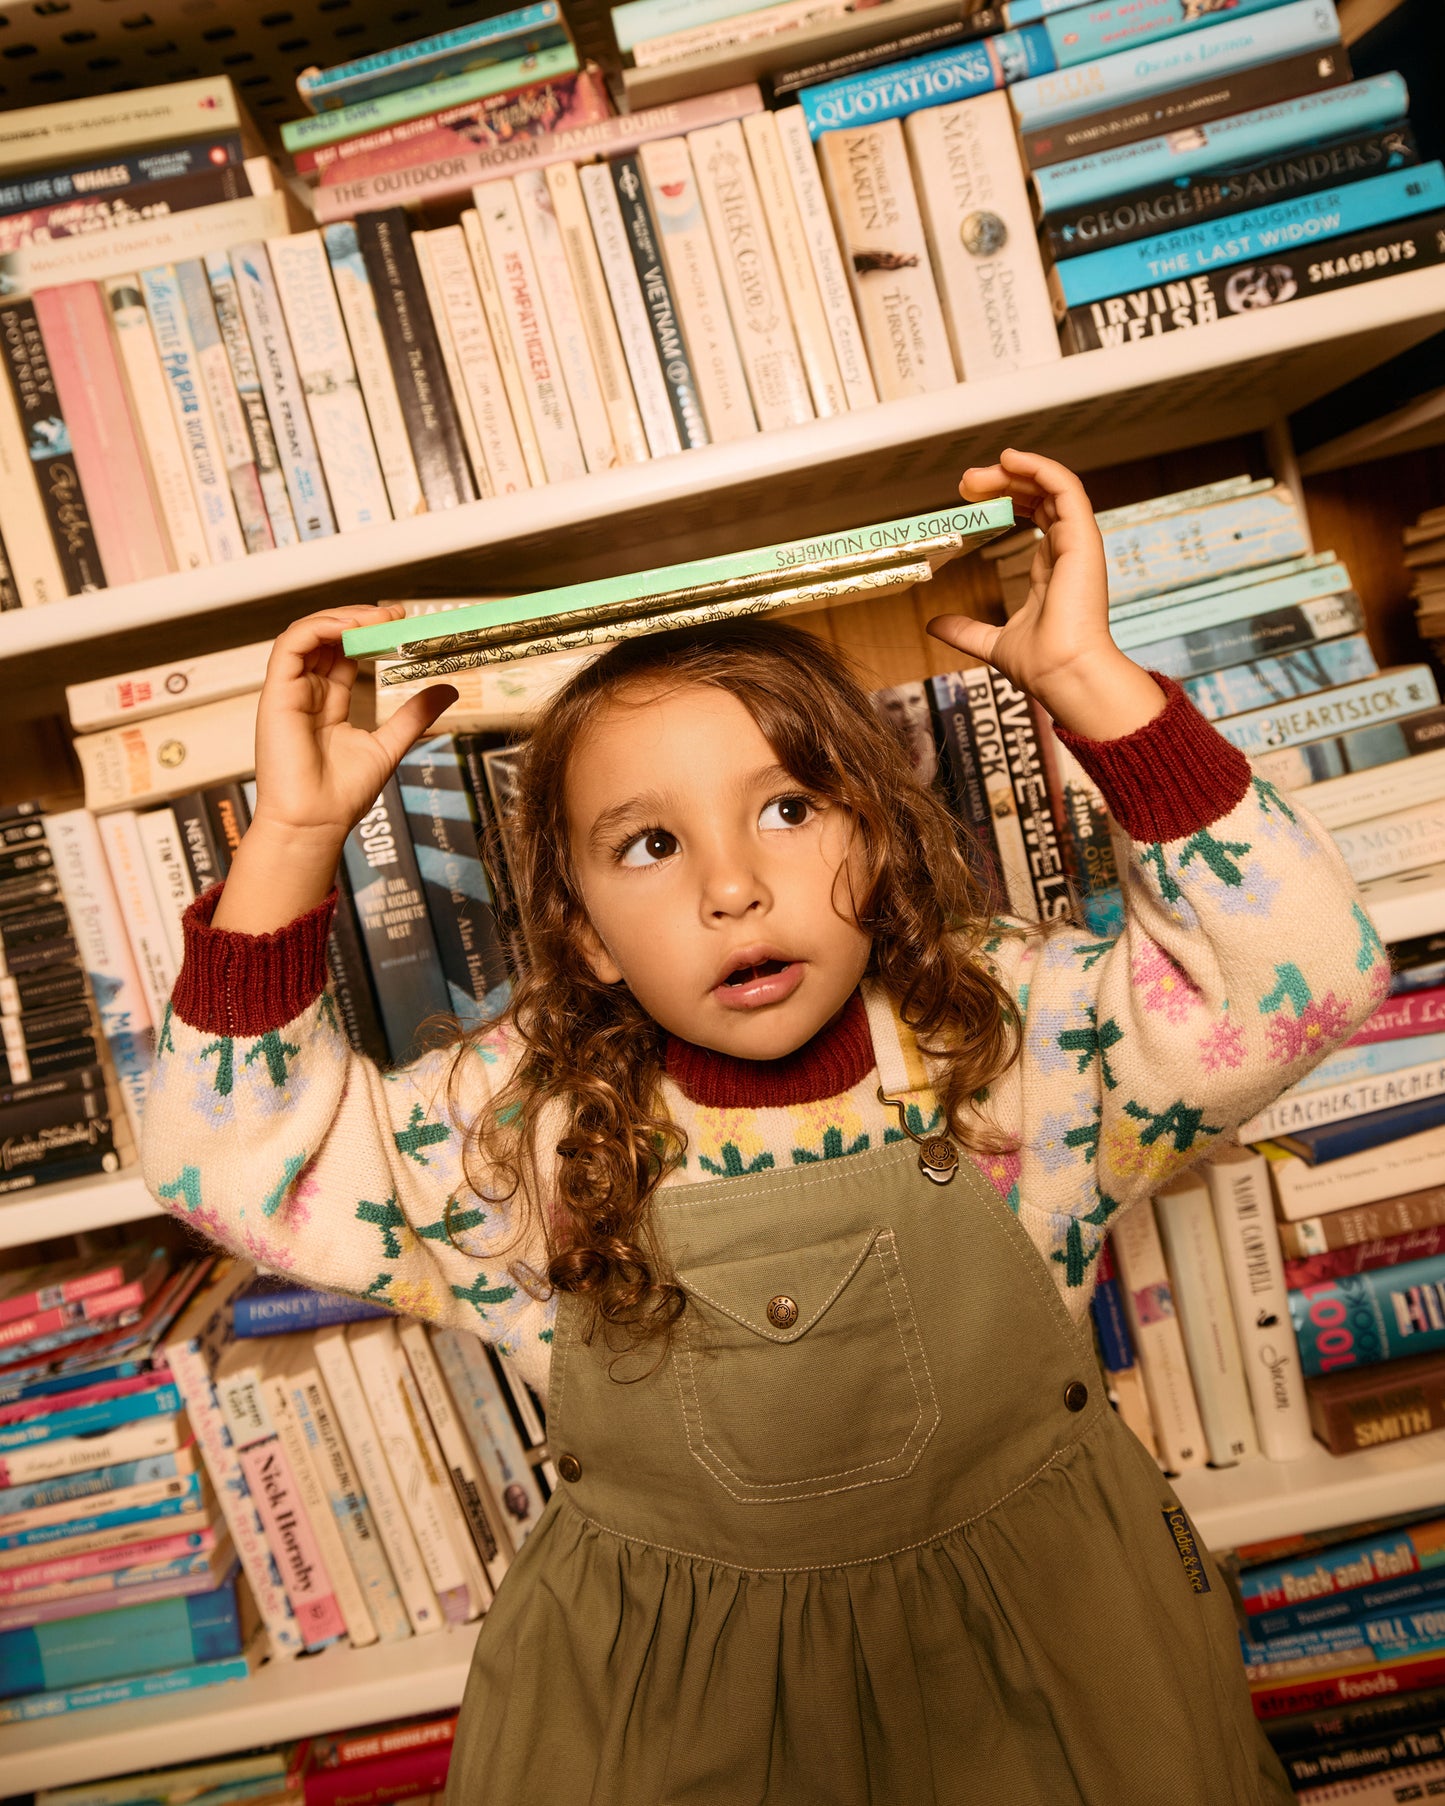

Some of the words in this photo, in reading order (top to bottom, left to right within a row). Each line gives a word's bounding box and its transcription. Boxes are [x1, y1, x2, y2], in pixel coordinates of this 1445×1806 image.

[815, 56, 991, 129] QUOTATIONS
[333, 180, 369, 203] THE
[373, 155, 467, 194] OUTDOOR
[479, 138, 539, 167] ROOM
[551, 121, 612, 150] JAMIE
[619, 105, 680, 135] DURIE
[866, 133, 892, 194] GEORGE
[938, 113, 978, 210] MARTIN
[961, 109, 987, 169] GEORGE
[72, 163, 131, 194] WHALES
[844, 135, 884, 231] MARTIN
[1076, 191, 1193, 240] GEORGE
[1227, 139, 1381, 201] SAUNDERS
[590, 174, 610, 215] NICK
[601, 221, 621, 263] CAVE
[719, 178, 750, 244] Nick
[735, 247, 767, 308] Cave
[1137, 230, 1205, 259] KARIN
[1213, 193, 1341, 239] SLAUGHTER
[787, 126, 809, 174] Richard
[817, 248, 845, 309] Invisible
[834, 315, 863, 387] Century
[1148, 253, 1189, 278] THE
[1196, 237, 1251, 265] LAST
[1259, 213, 1342, 249] WIDOW
[1307, 240, 1417, 282] SKAGBOYS
[374, 221, 401, 285] MARGARET
[391, 288, 415, 342] ATWOOD
[406, 349, 422, 368] The
[682, 239, 707, 308] MEMOIRS
[997, 270, 1023, 324] DANCE
[152, 300, 183, 348] LITTLE
[504, 260, 549, 381] SYMPATHIZER
[641, 266, 681, 359] VIETNAM
[699, 314, 714, 334] OF
[905, 304, 928, 351] GAME
[974, 263, 1011, 358] DRAGONS
[1091, 275, 1214, 328] IRVINE
[1, 311, 40, 410] DOWNER
[19, 317, 52, 395] LESLEY
[706, 340, 718, 351] A
[881, 288, 918, 380] THRONES
[161, 351, 199, 413] PARIS
[262, 335, 286, 395] LAURA
[279, 400, 302, 459] FRIDAY
[711, 357, 731, 410] GEISHA
[184, 417, 215, 487] BOOKSHOP
[869, 524, 913, 548] AND
[917, 509, 989, 537] WORDS
[775, 536, 864, 567] NUMBERS
[964, 683, 1005, 778] BLOCK
[1275, 688, 1400, 736] HEARTSICK
[418, 757, 438, 785] The
[949, 714, 976, 778] CHARLAINE
[60, 825, 75, 837] A
[218, 800, 240, 847] FIGHT
[423, 788, 454, 859] Stranger's
[1070, 794, 1092, 838] SING
[66, 843, 85, 880] SPOT
[156, 839, 173, 862] TIN
[167, 864, 186, 897] TOYS
[183, 819, 210, 872] NEVER
[1020, 810, 1073, 924] WELS
[387, 889, 419, 909] KICKED
[388, 877, 408, 894] GIRL
[443, 862, 465, 904] Child
[79, 905, 111, 966] BOTHER
[364, 914, 384, 929] THE
[383, 904, 426, 925] HORNETS'
[387, 922, 411, 941] NEST
[456, 916, 476, 950] Alan
[1267, 1092, 1355, 1129] TEACHER
[1229, 1175, 1259, 1221] NAOMI
[1239, 1224, 1274, 1295] CAMPBELL
[249, 1294, 310, 1321] HONEY
[1301, 1278, 1356, 1371] 1001
[227, 1388, 246, 1420] Girl
[1258, 1342, 1300, 1415] Swan
[239, 1383, 263, 1429] Funny
[1354, 1409, 1432, 1446] SMITH
[173, 1347, 203, 1402] MARK
[233, 1515, 256, 1553] RED
[255, 1456, 287, 1508] Nick
[275, 1512, 315, 1594] Hornby
[1168, 1514, 1194, 1555] Goldie
[1180, 1554, 1197, 1567] &
[1184, 1565, 1203, 1592] Ace
[1282, 1562, 1333, 1602] Rock
[1333, 1554, 1374, 1588] and
[1373, 1544, 1414, 1578] Roll
[1367, 1620, 1405, 1643] KILL
[1261, 1684, 1335, 1716] strange
[1338, 1668, 1398, 1700] foods
[342, 1738, 379, 1759] STEVE
[1293, 1759, 1319, 1779] The
[1390, 1740, 1407, 1758] of
